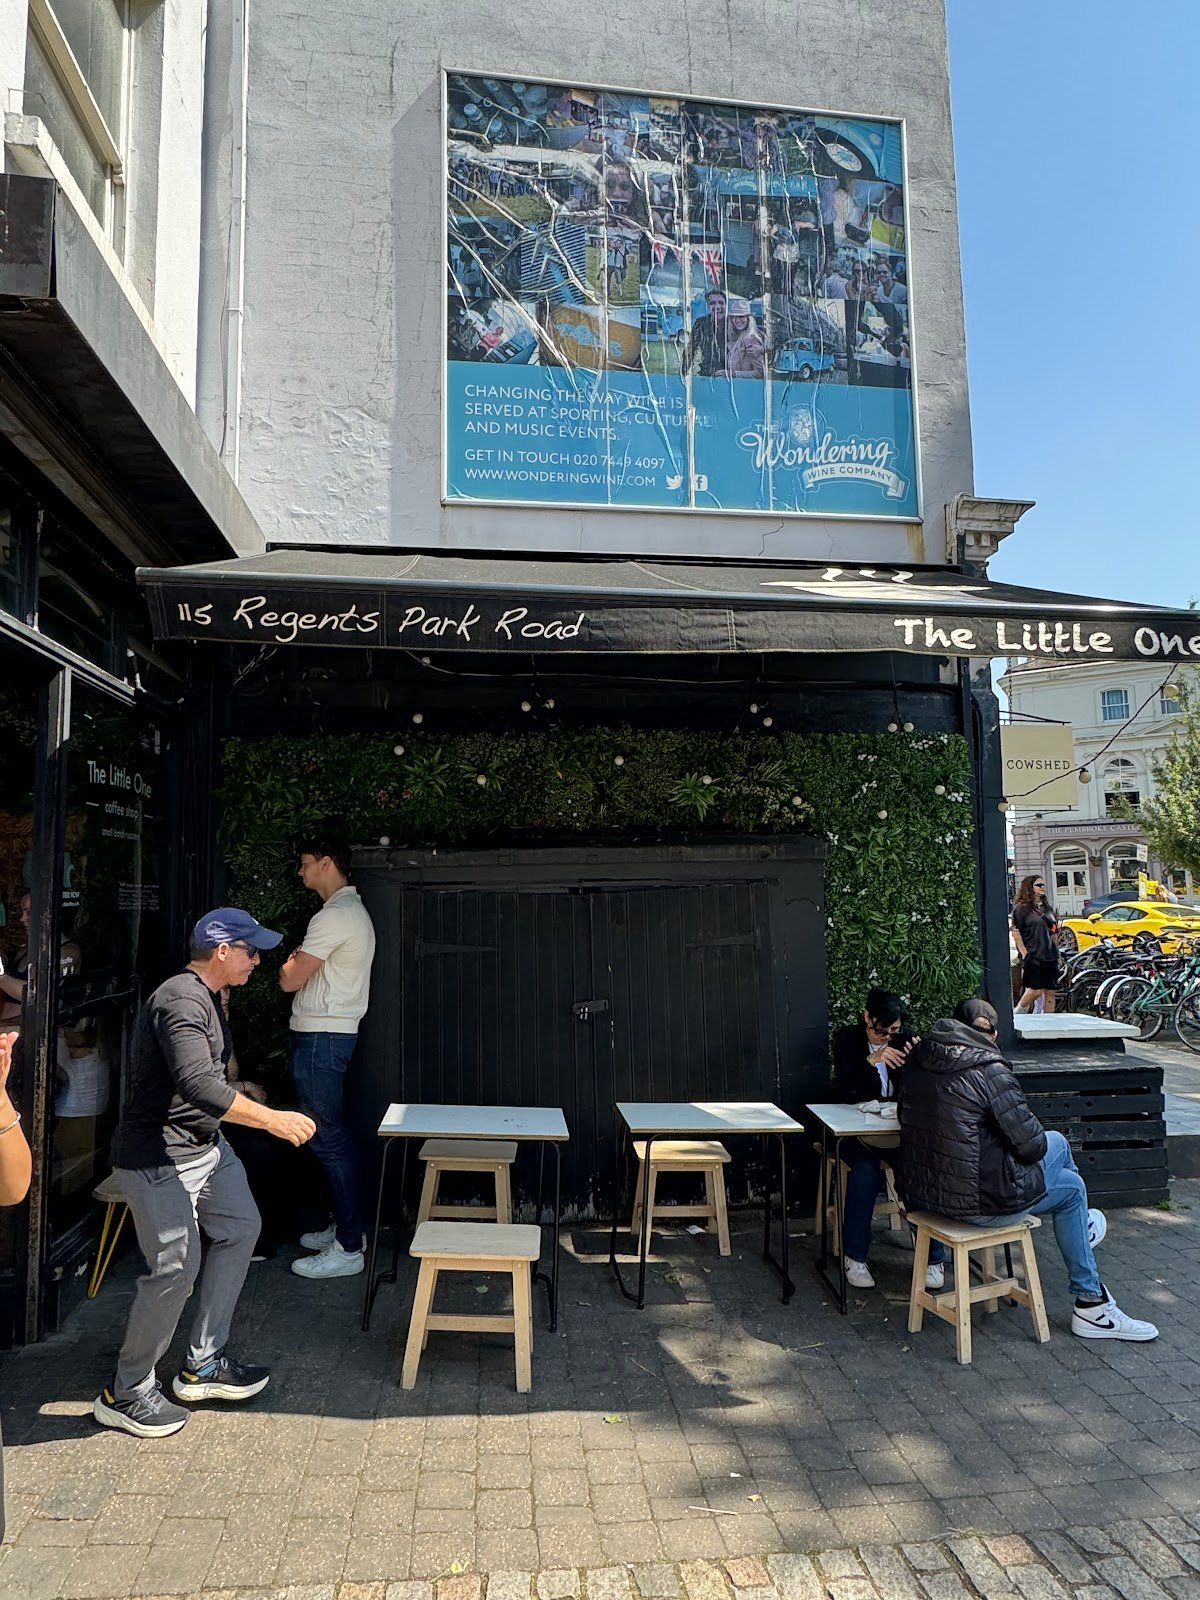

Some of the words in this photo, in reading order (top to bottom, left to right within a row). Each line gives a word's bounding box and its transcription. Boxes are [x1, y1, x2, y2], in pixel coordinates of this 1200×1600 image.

[464, 384, 552, 401] CHANGING
[557, 388, 586, 403] THE
[590, 392, 622, 405] WAY
[671, 395, 684, 409] IS
[464, 402, 524, 417] SERVED
[527, 405, 547, 418] AT
[464, 420, 501, 434] AND
[505, 422, 555, 437] MUSIC
[464, 448, 494, 461] GET
[498, 450, 514, 462] IN
[517, 450, 570, 465] TOUCH
[573, 453, 598, 467] 020
[600, 454, 632, 468] 7449
[634, 456, 666, 470] 4097
[740, 431, 893, 470] Wondering
[464, 468, 656, 487] WWW.WONDERINGWINE.COM
[807, 464, 836, 482] WINE
[839, 465, 893, 483] COMPANY
[177, 602, 213, 625] 115
[233, 596, 381, 643] Regents
[398, 604, 481, 642] Park
[494, 607, 585, 640] Road
[893, 617, 977, 650] The
[996, 621, 1114, 653] Little
[1134, 627, 1200, 656] One
[1006, 759, 1071, 770] COWSHED
[87, 760, 106, 785] The
[109, 763, 132, 790] Little
[133, 773, 152, 799] One
[104, 800, 125, 816] coffee
[125, 804, 139, 821] shop
[1047, 826, 1063, 834] THE
